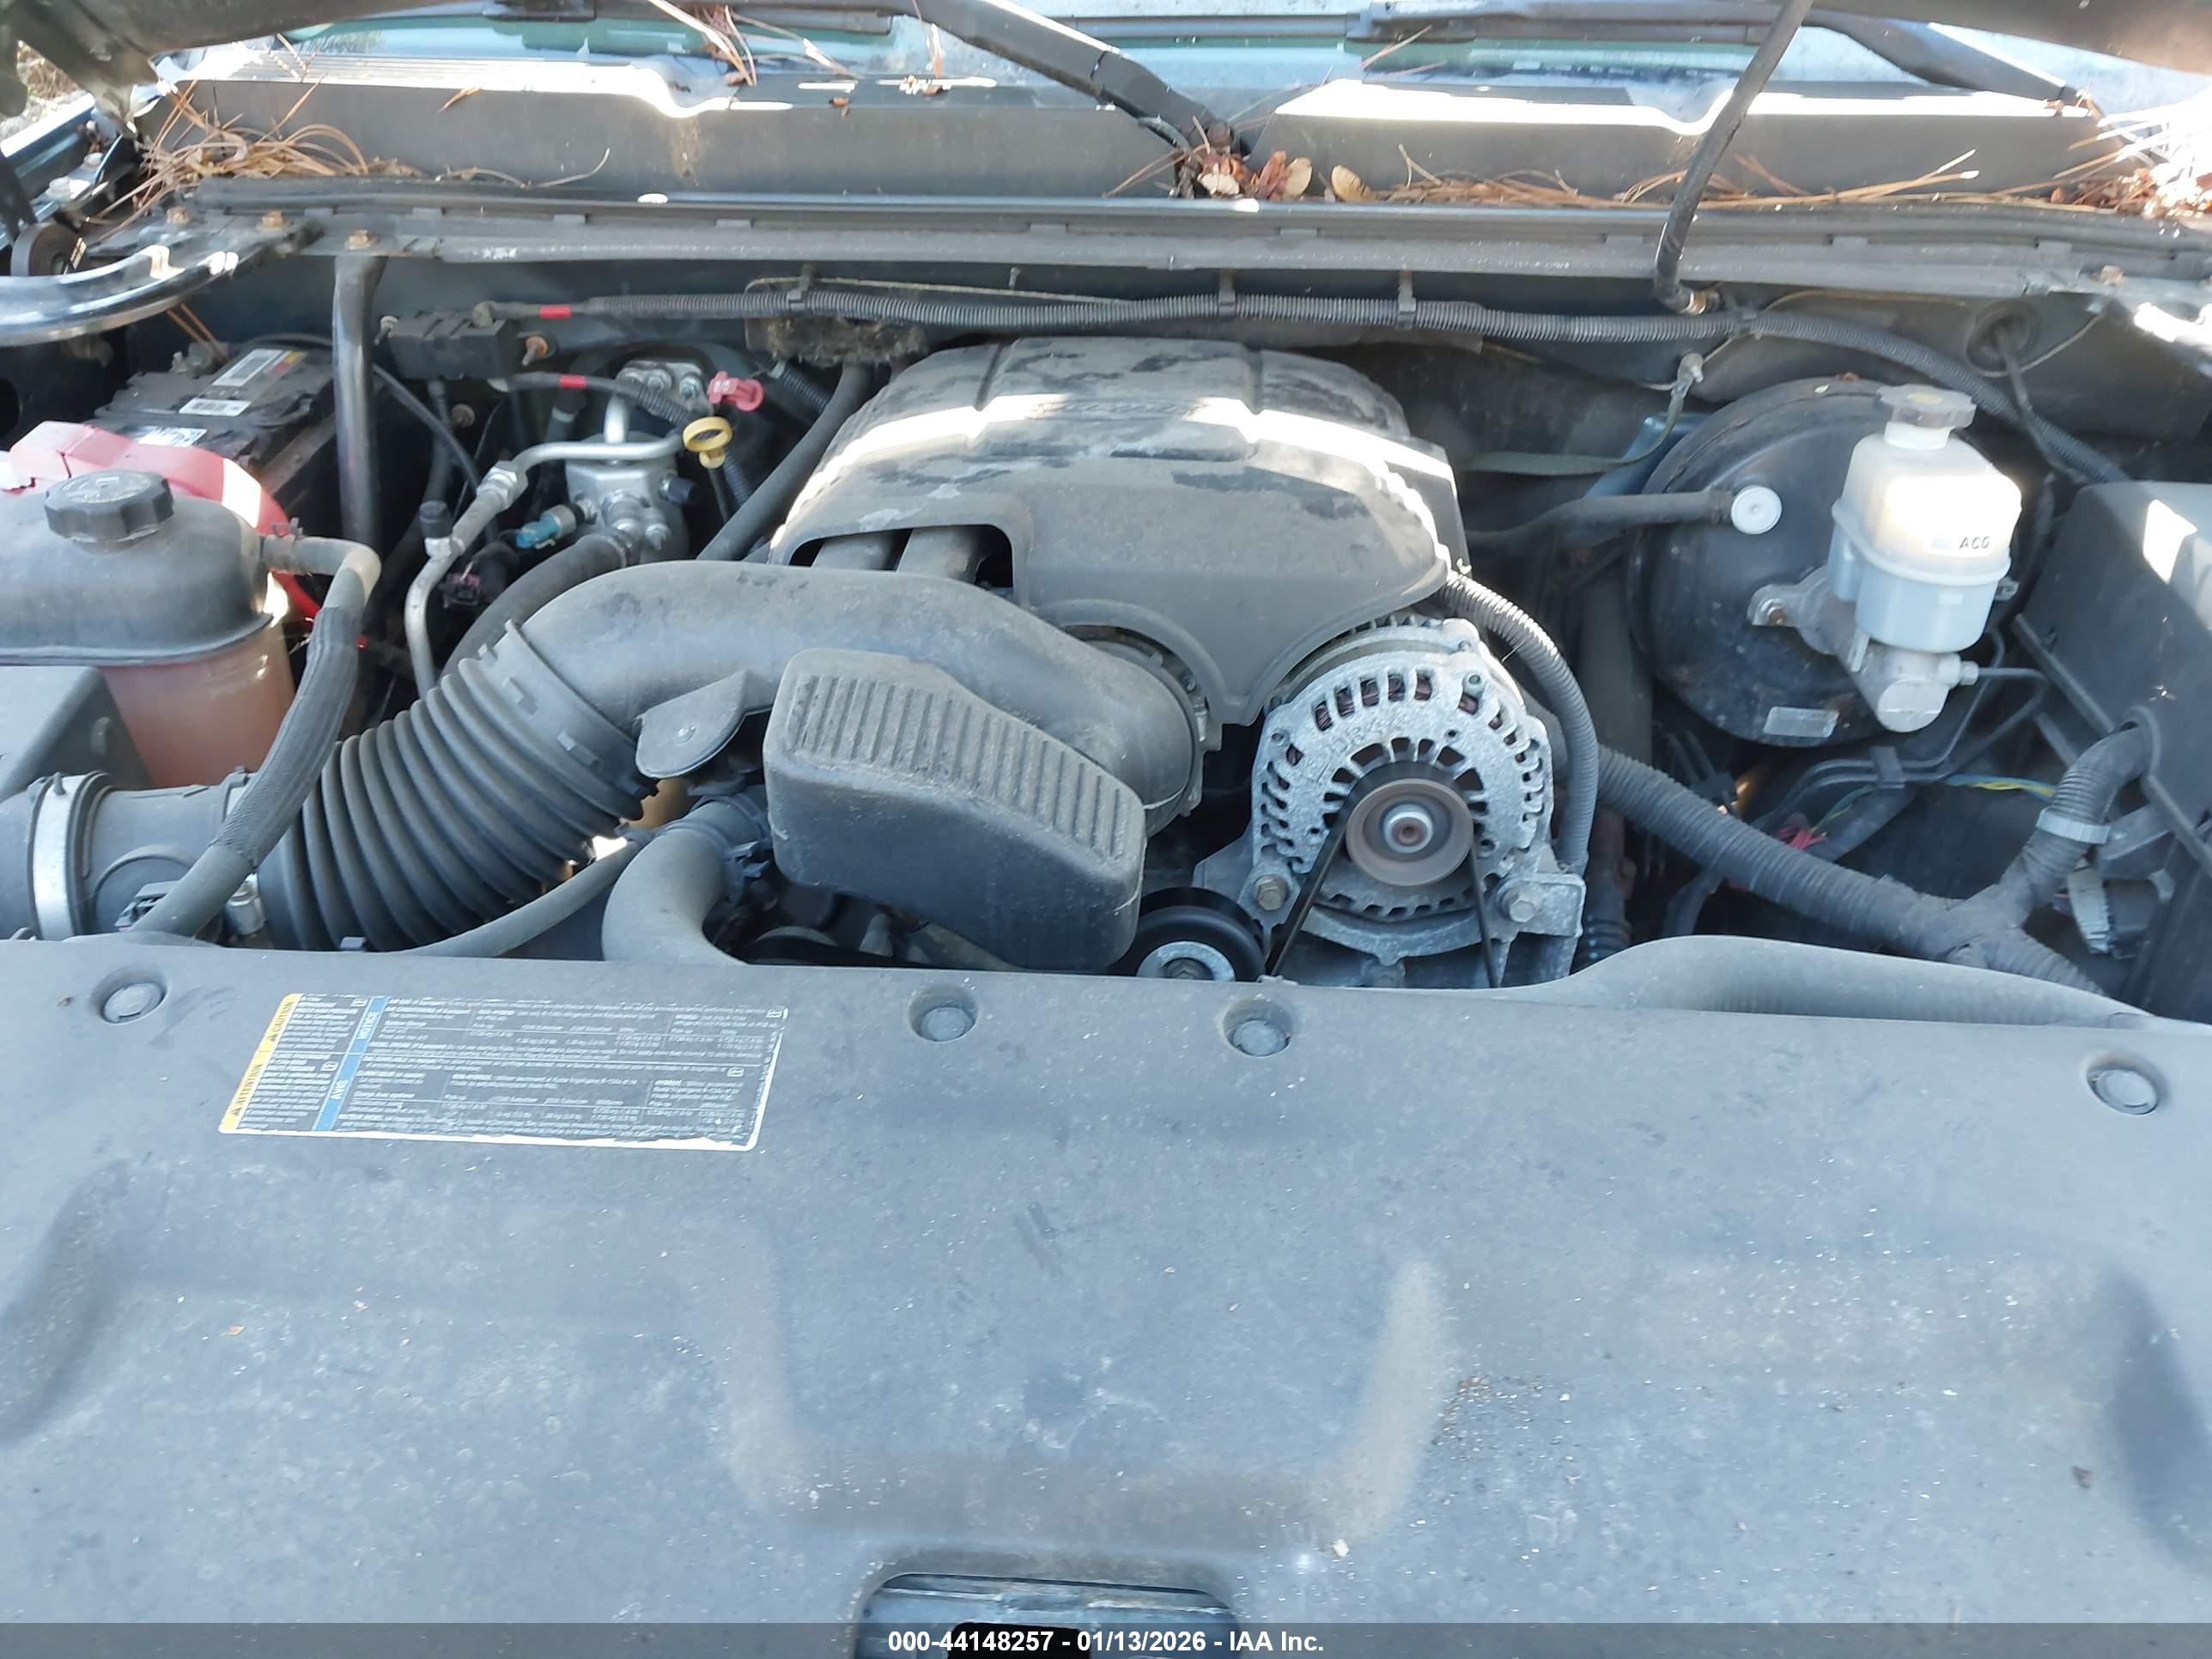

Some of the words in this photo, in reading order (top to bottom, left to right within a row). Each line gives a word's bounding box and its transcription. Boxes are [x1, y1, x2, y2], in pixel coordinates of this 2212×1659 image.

[275, 1001, 294, 1034] CAUTION
[356, 1011, 380, 1040] NOTICE
[236, 1064, 264, 1108] ATTENTION
